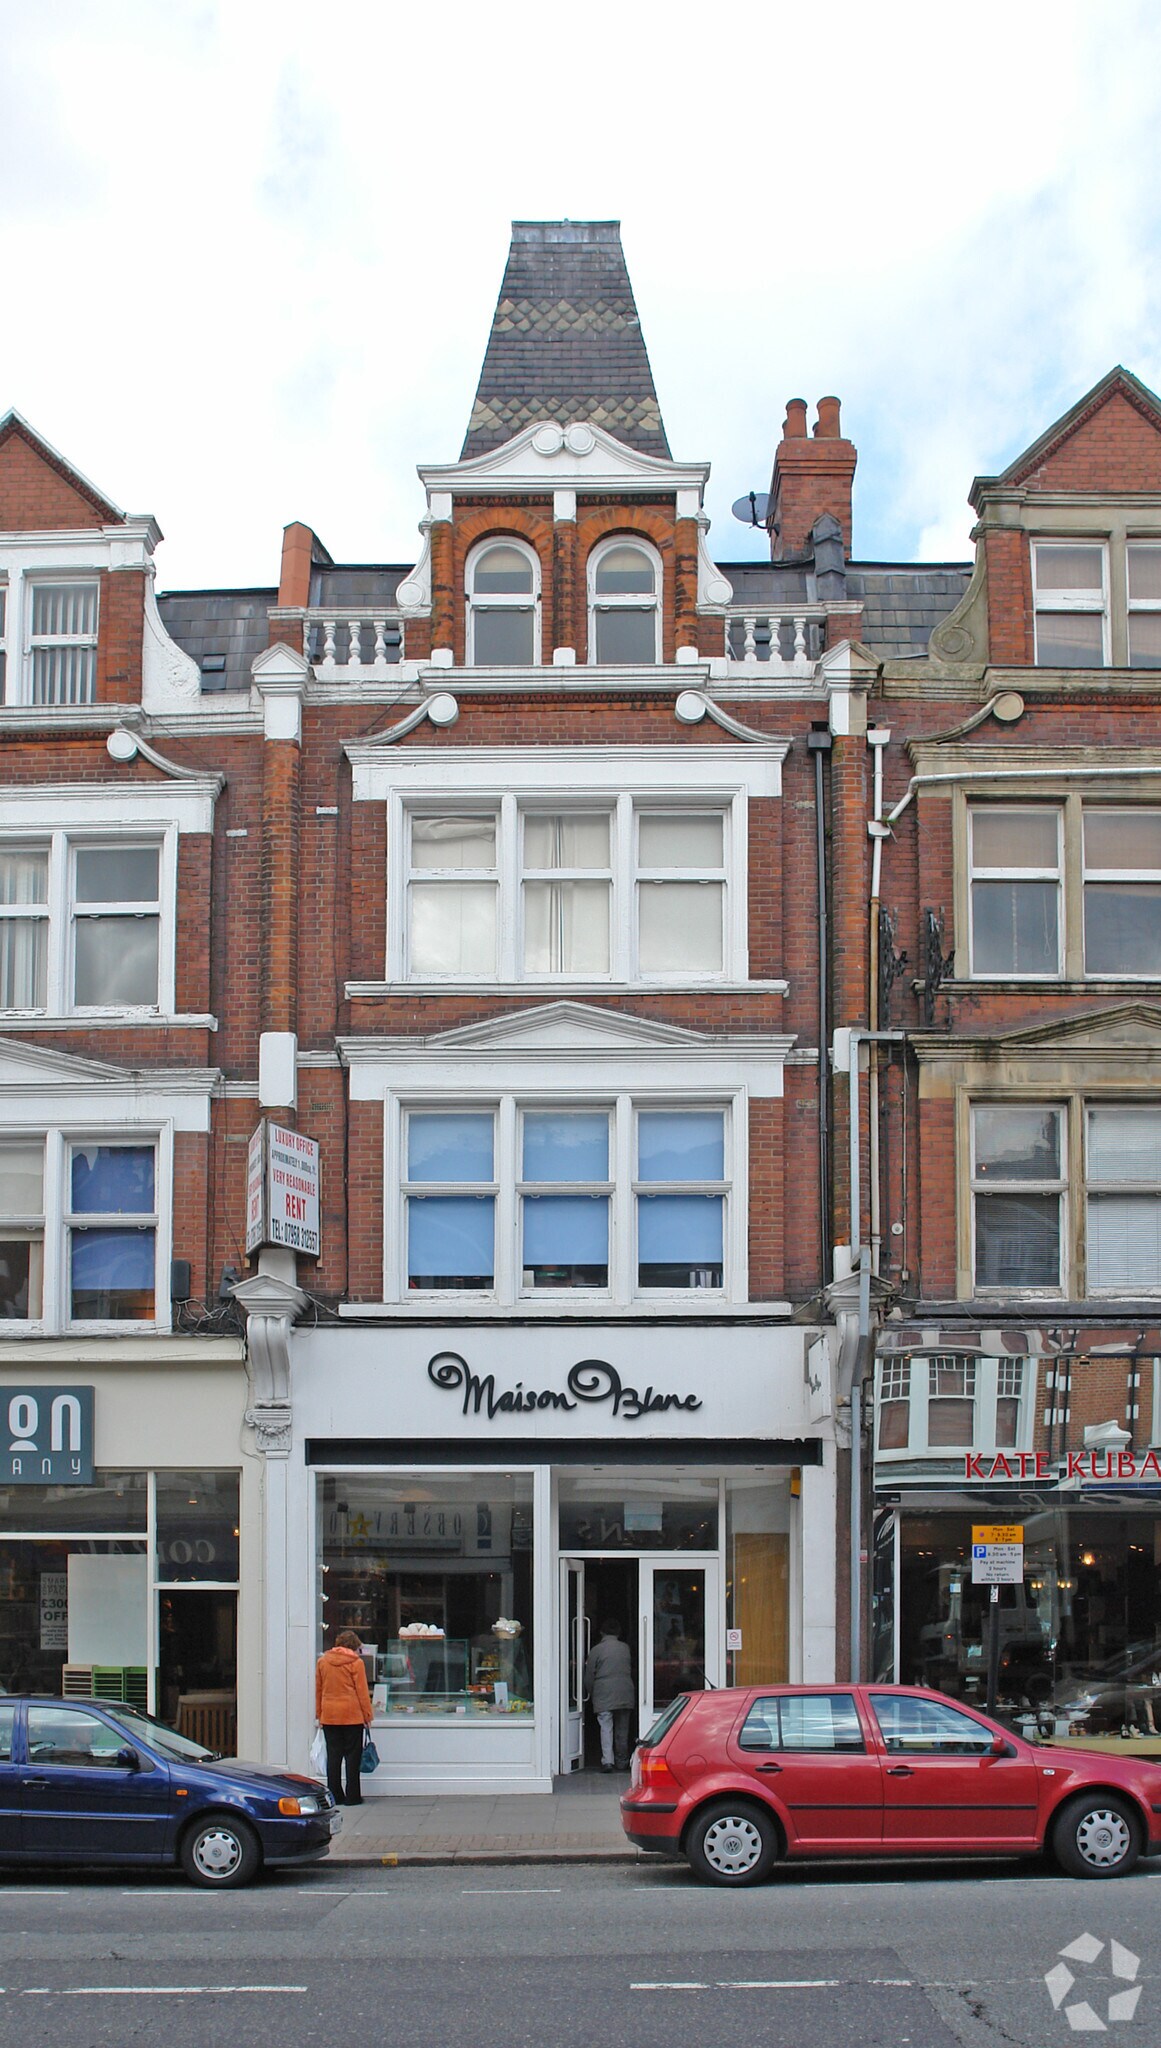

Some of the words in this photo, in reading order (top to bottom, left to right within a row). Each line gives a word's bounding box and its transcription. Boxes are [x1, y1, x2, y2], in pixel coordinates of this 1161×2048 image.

[274, 1128, 295, 1149] LUXURY
[296, 1136, 314, 1156] OFFICE
[272, 1168, 285, 1185] VERY
[286, 1173, 316, 1197] REASONABLE
[285, 1193, 306, 1222] RENT
[272, 1218, 284, 1241] TEL:
[427, 1351, 577, 1419] Maison
[567, 1359, 703, 1420] Blanc
[965, 1451, 1051, 1478] KATE
[1067, 1451, 1161, 1478] KUBA
[44, 1611, 68, 1621] OFF
